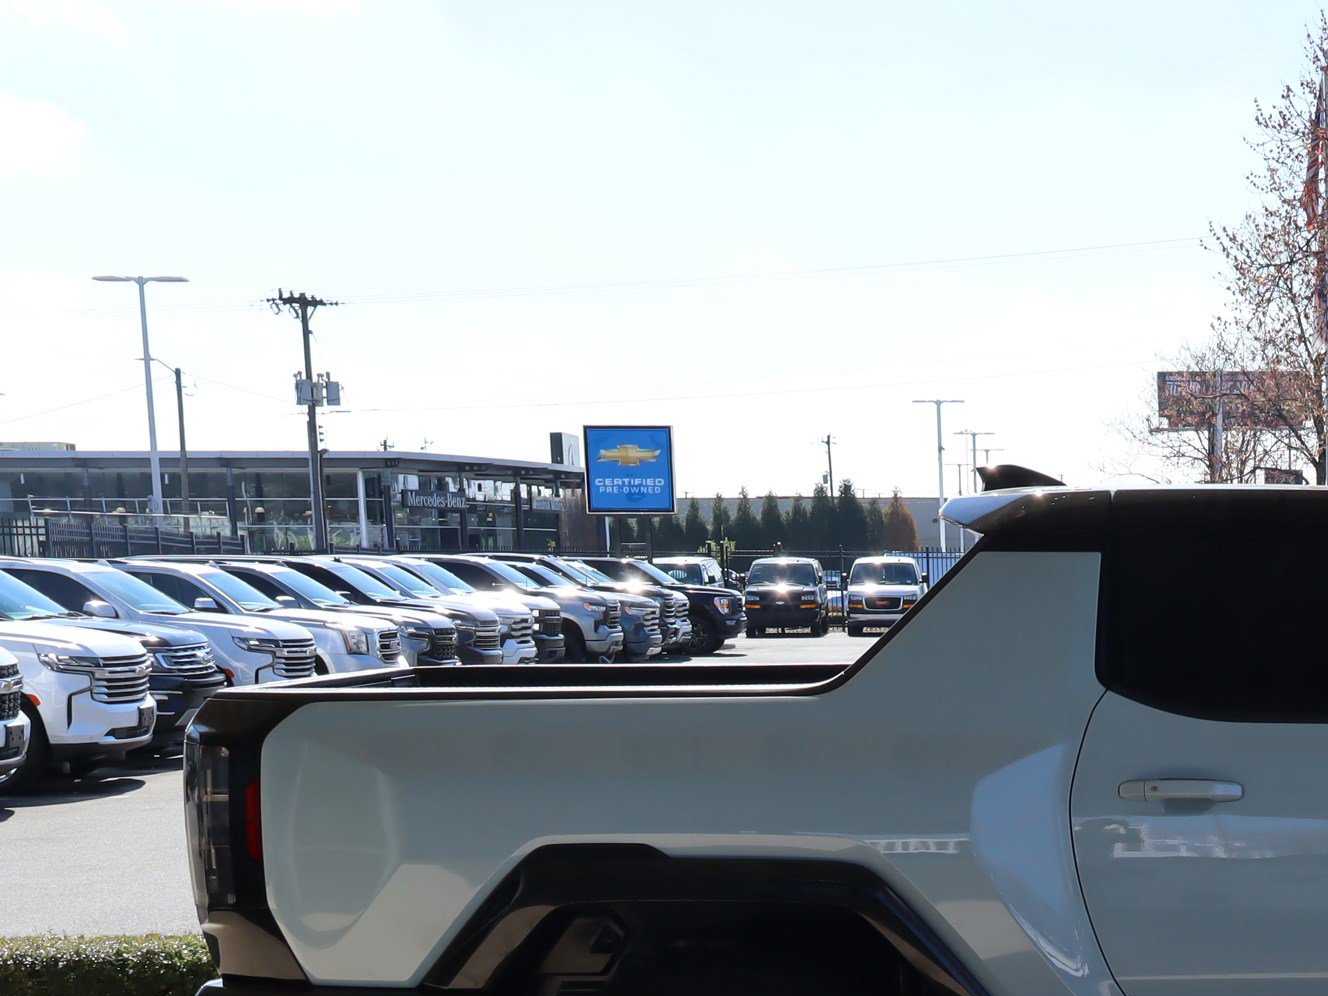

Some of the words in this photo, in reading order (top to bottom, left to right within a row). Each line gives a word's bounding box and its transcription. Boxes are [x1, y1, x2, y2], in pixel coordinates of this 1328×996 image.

[595, 478, 665, 486] CERTIFIED
[599, 486, 661, 494] PRE-OWNED
[407, 491, 466, 508] Mercedes-Benz
